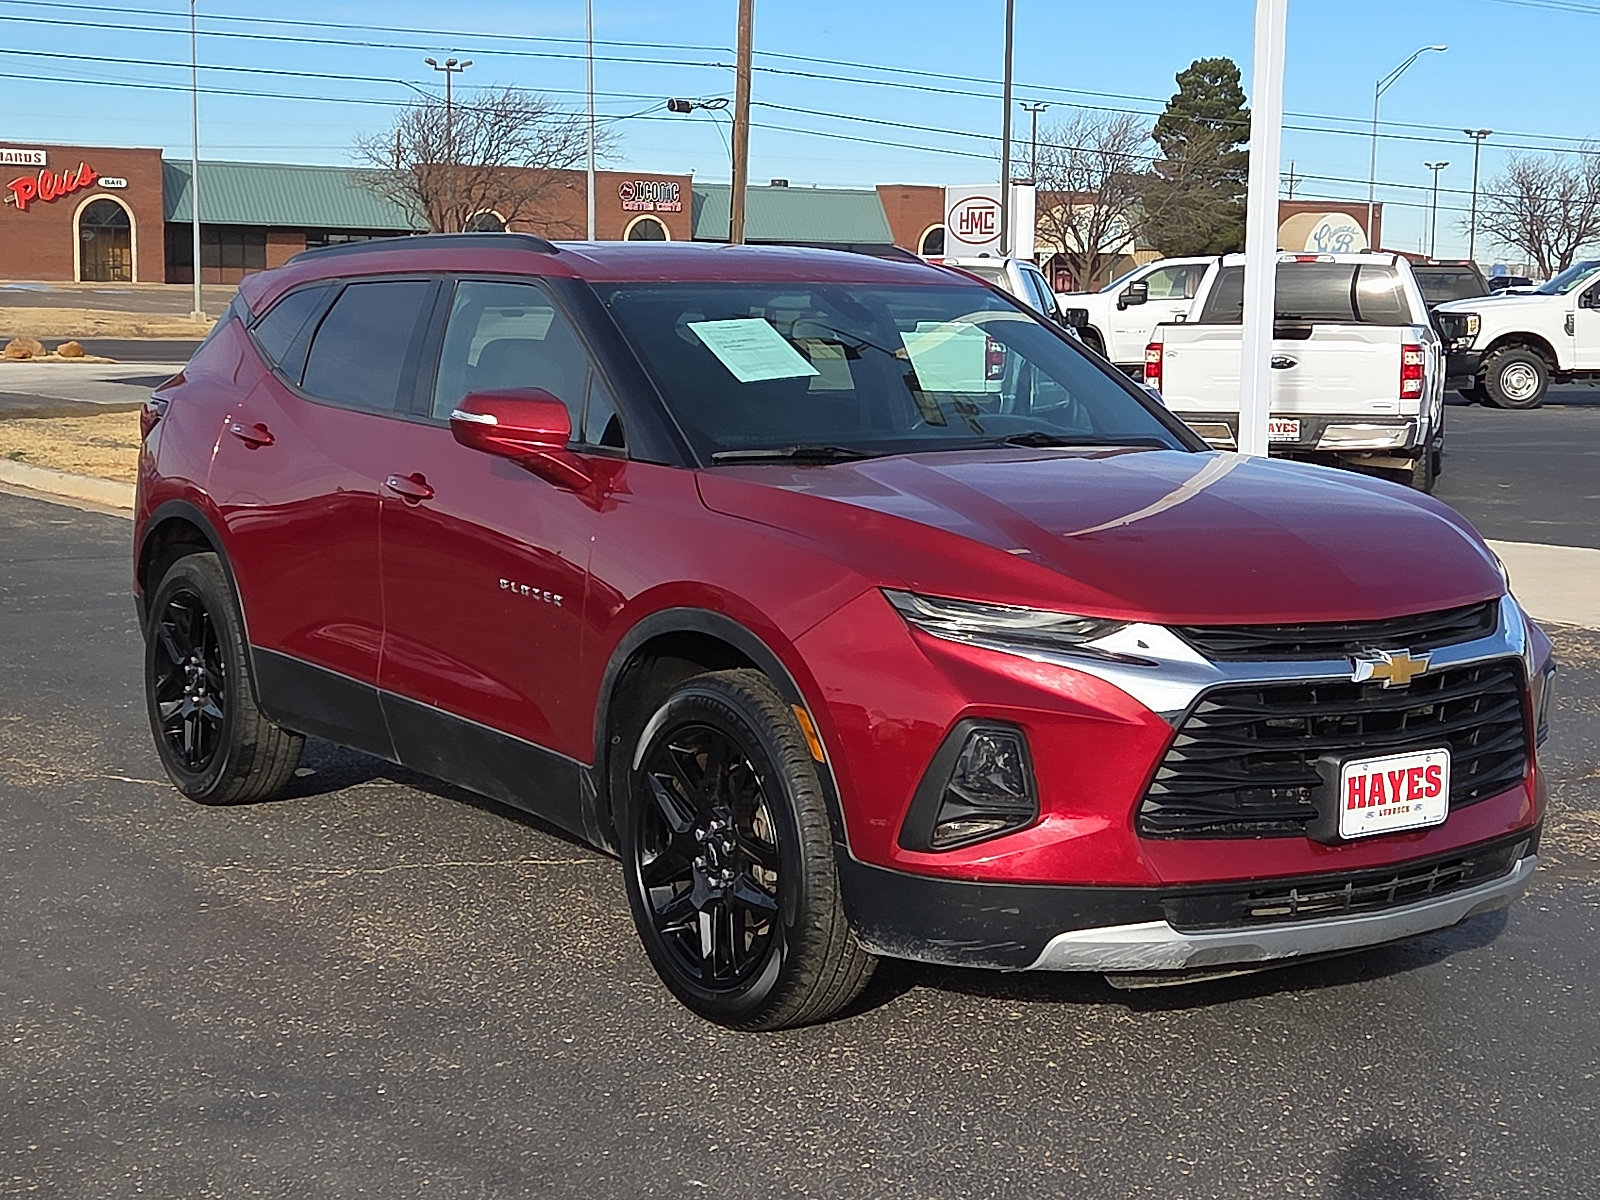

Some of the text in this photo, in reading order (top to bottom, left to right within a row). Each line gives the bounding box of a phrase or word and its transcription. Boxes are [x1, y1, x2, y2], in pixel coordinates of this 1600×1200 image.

[634, 181, 680, 202] ICONIC
[959, 206, 995, 235] HMC
[1268, 422, 1298, 433] AYES
[499, 578, 563, 607] BLAZER
[1347, 764, 1442, 810] HAYES
